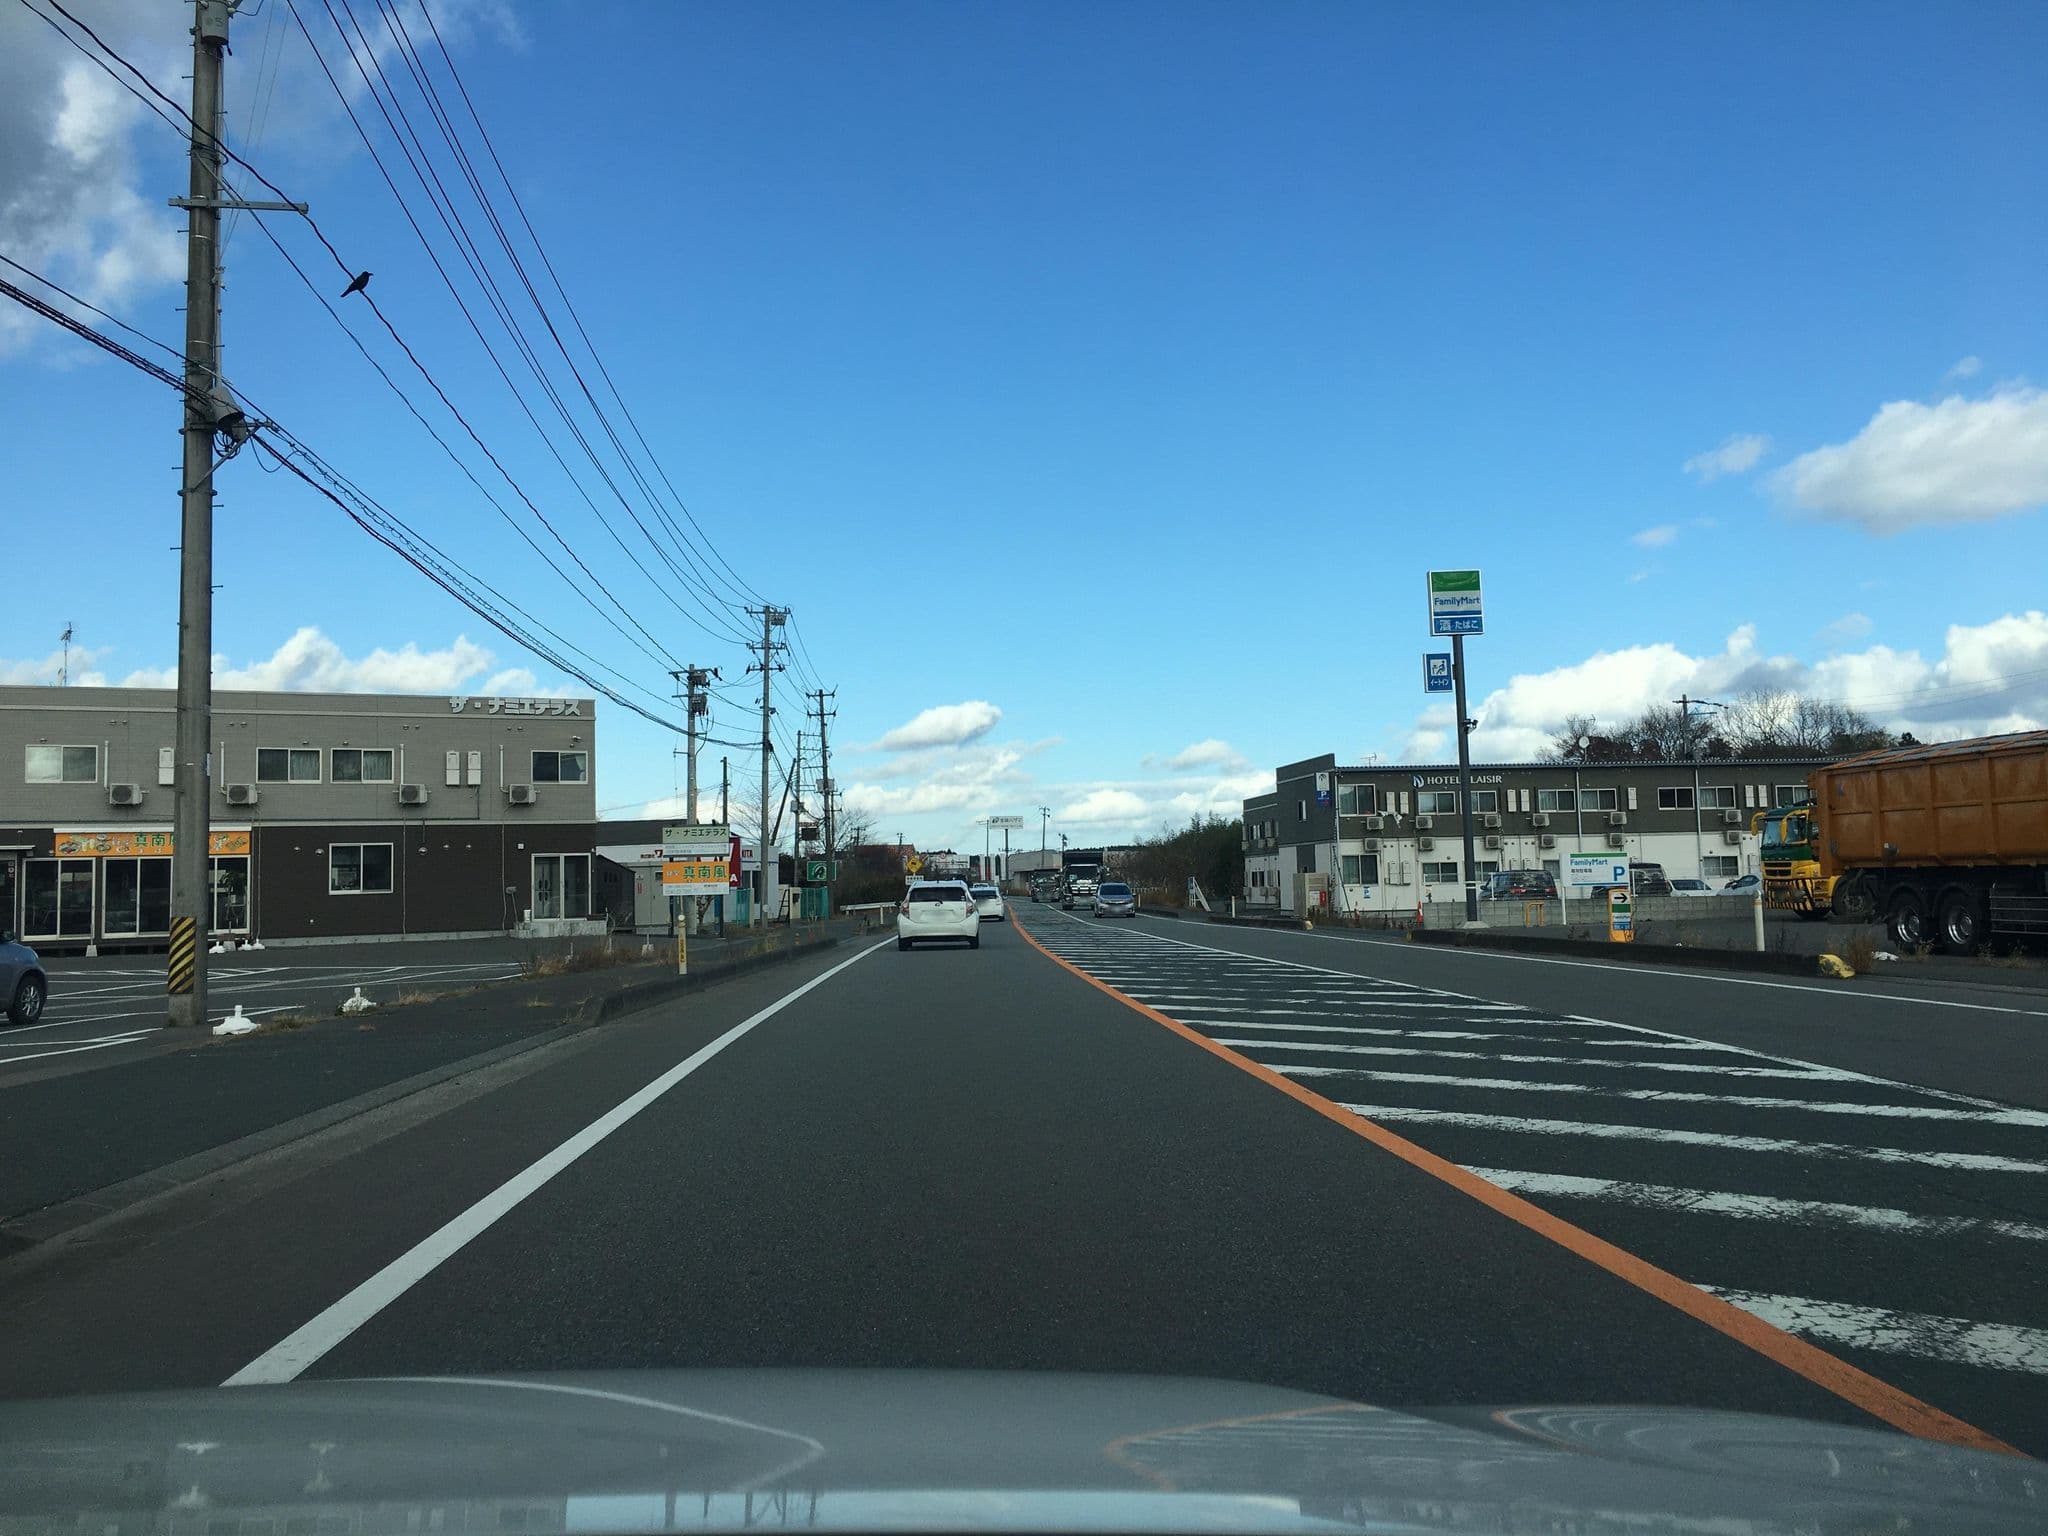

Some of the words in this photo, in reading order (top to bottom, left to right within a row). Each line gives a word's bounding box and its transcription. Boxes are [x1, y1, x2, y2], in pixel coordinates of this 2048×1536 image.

[1434, 596, 1480, 606] FamilyMart
[449, 697, 580, 715] ザ・ナミエテラス
[1427, 776, 1461, 785] HOTEL
[1470, 775, 1502, 784] LAISIR
[1613, 866, 1625, 881] P
